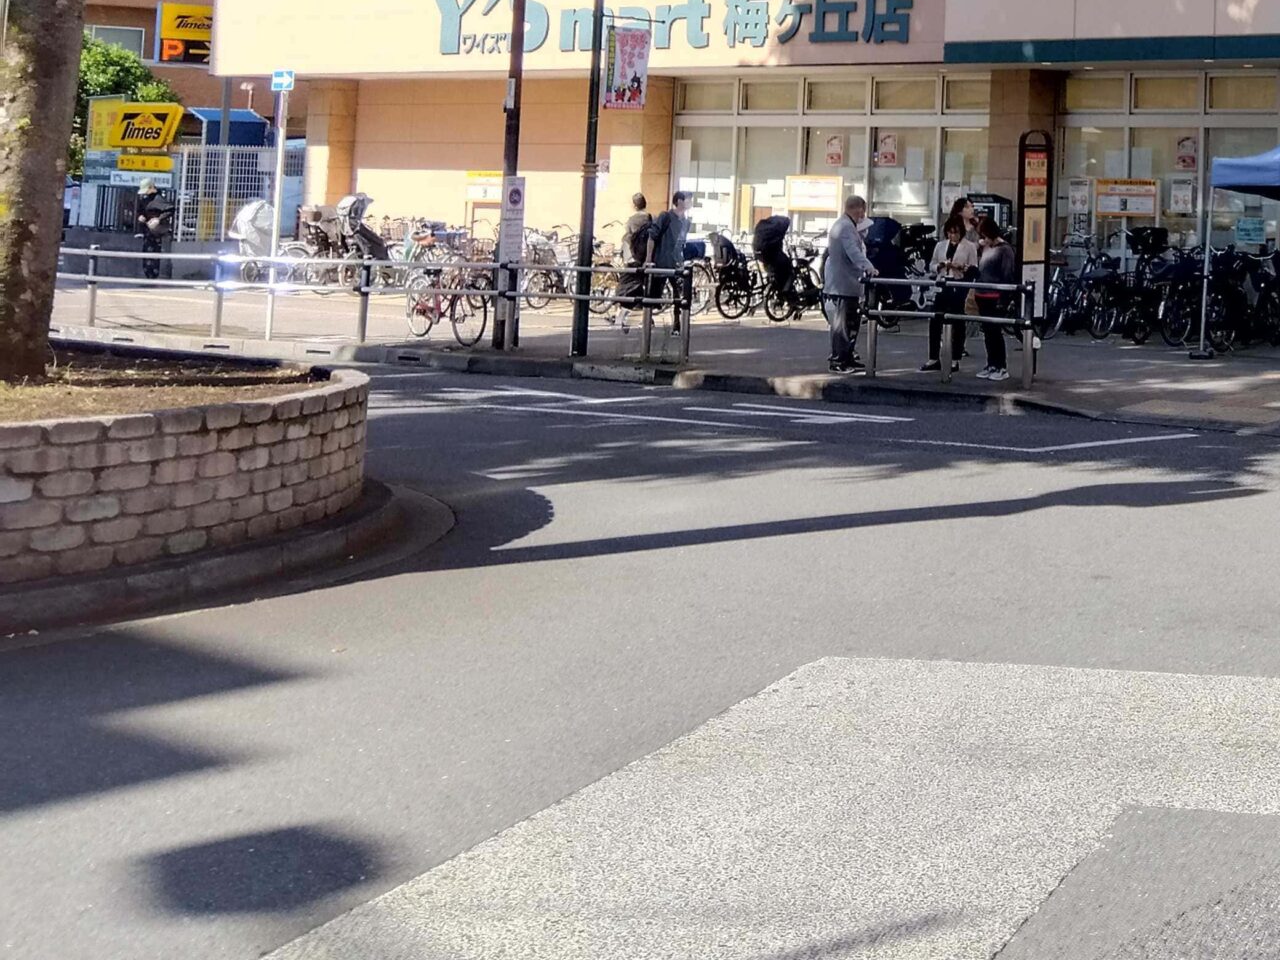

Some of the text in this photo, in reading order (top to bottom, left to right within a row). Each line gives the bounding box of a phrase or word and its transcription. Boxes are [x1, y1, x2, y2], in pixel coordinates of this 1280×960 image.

[175, 15, 213, 29] Times
[161, 39, 185, 61] P
[462, 33, 507, 54] ワイズ
[120, 113, 168, 141] Times
